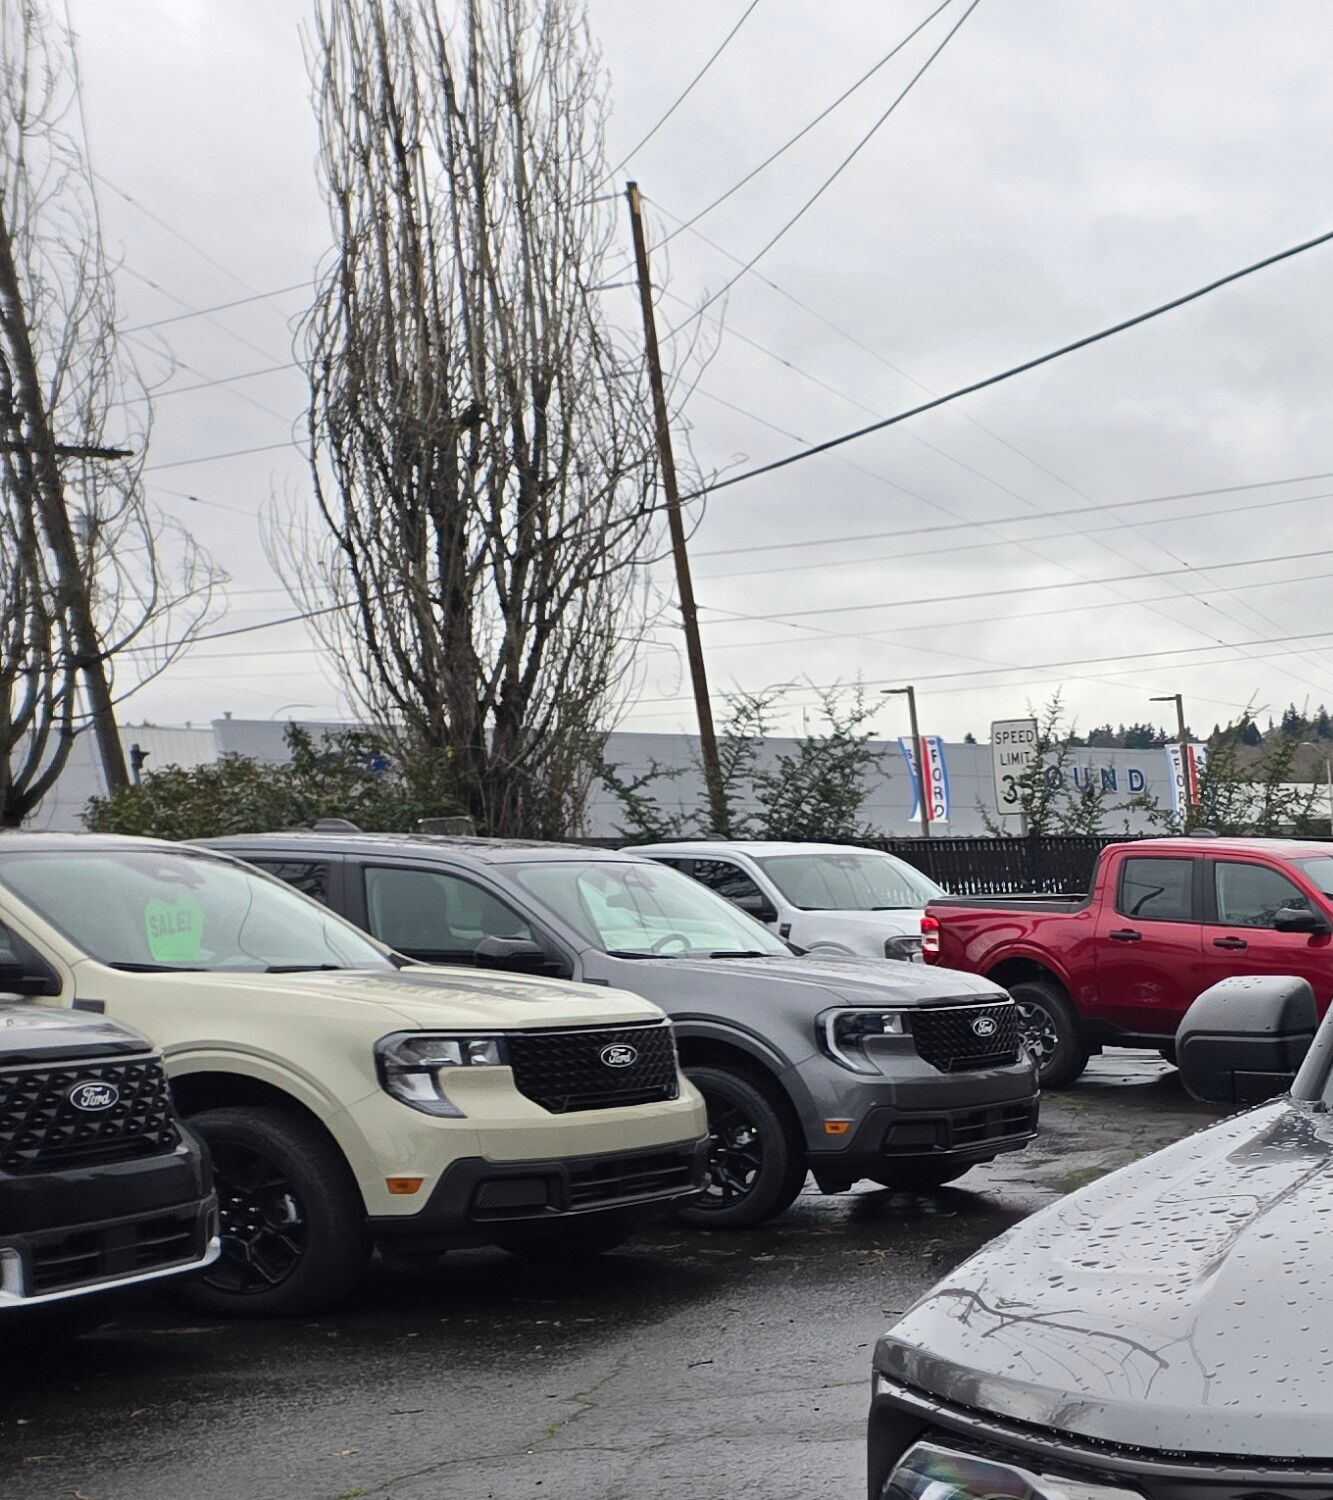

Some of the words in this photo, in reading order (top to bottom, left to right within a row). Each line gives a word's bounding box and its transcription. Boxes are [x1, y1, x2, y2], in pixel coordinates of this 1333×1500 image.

[995, 730, 1034, 745] SPEED
[1000, 751, 1031, 766] LIMIT
[930, 749, 945, 818] FORD
[1045, 765, 1145, 793] OUND
